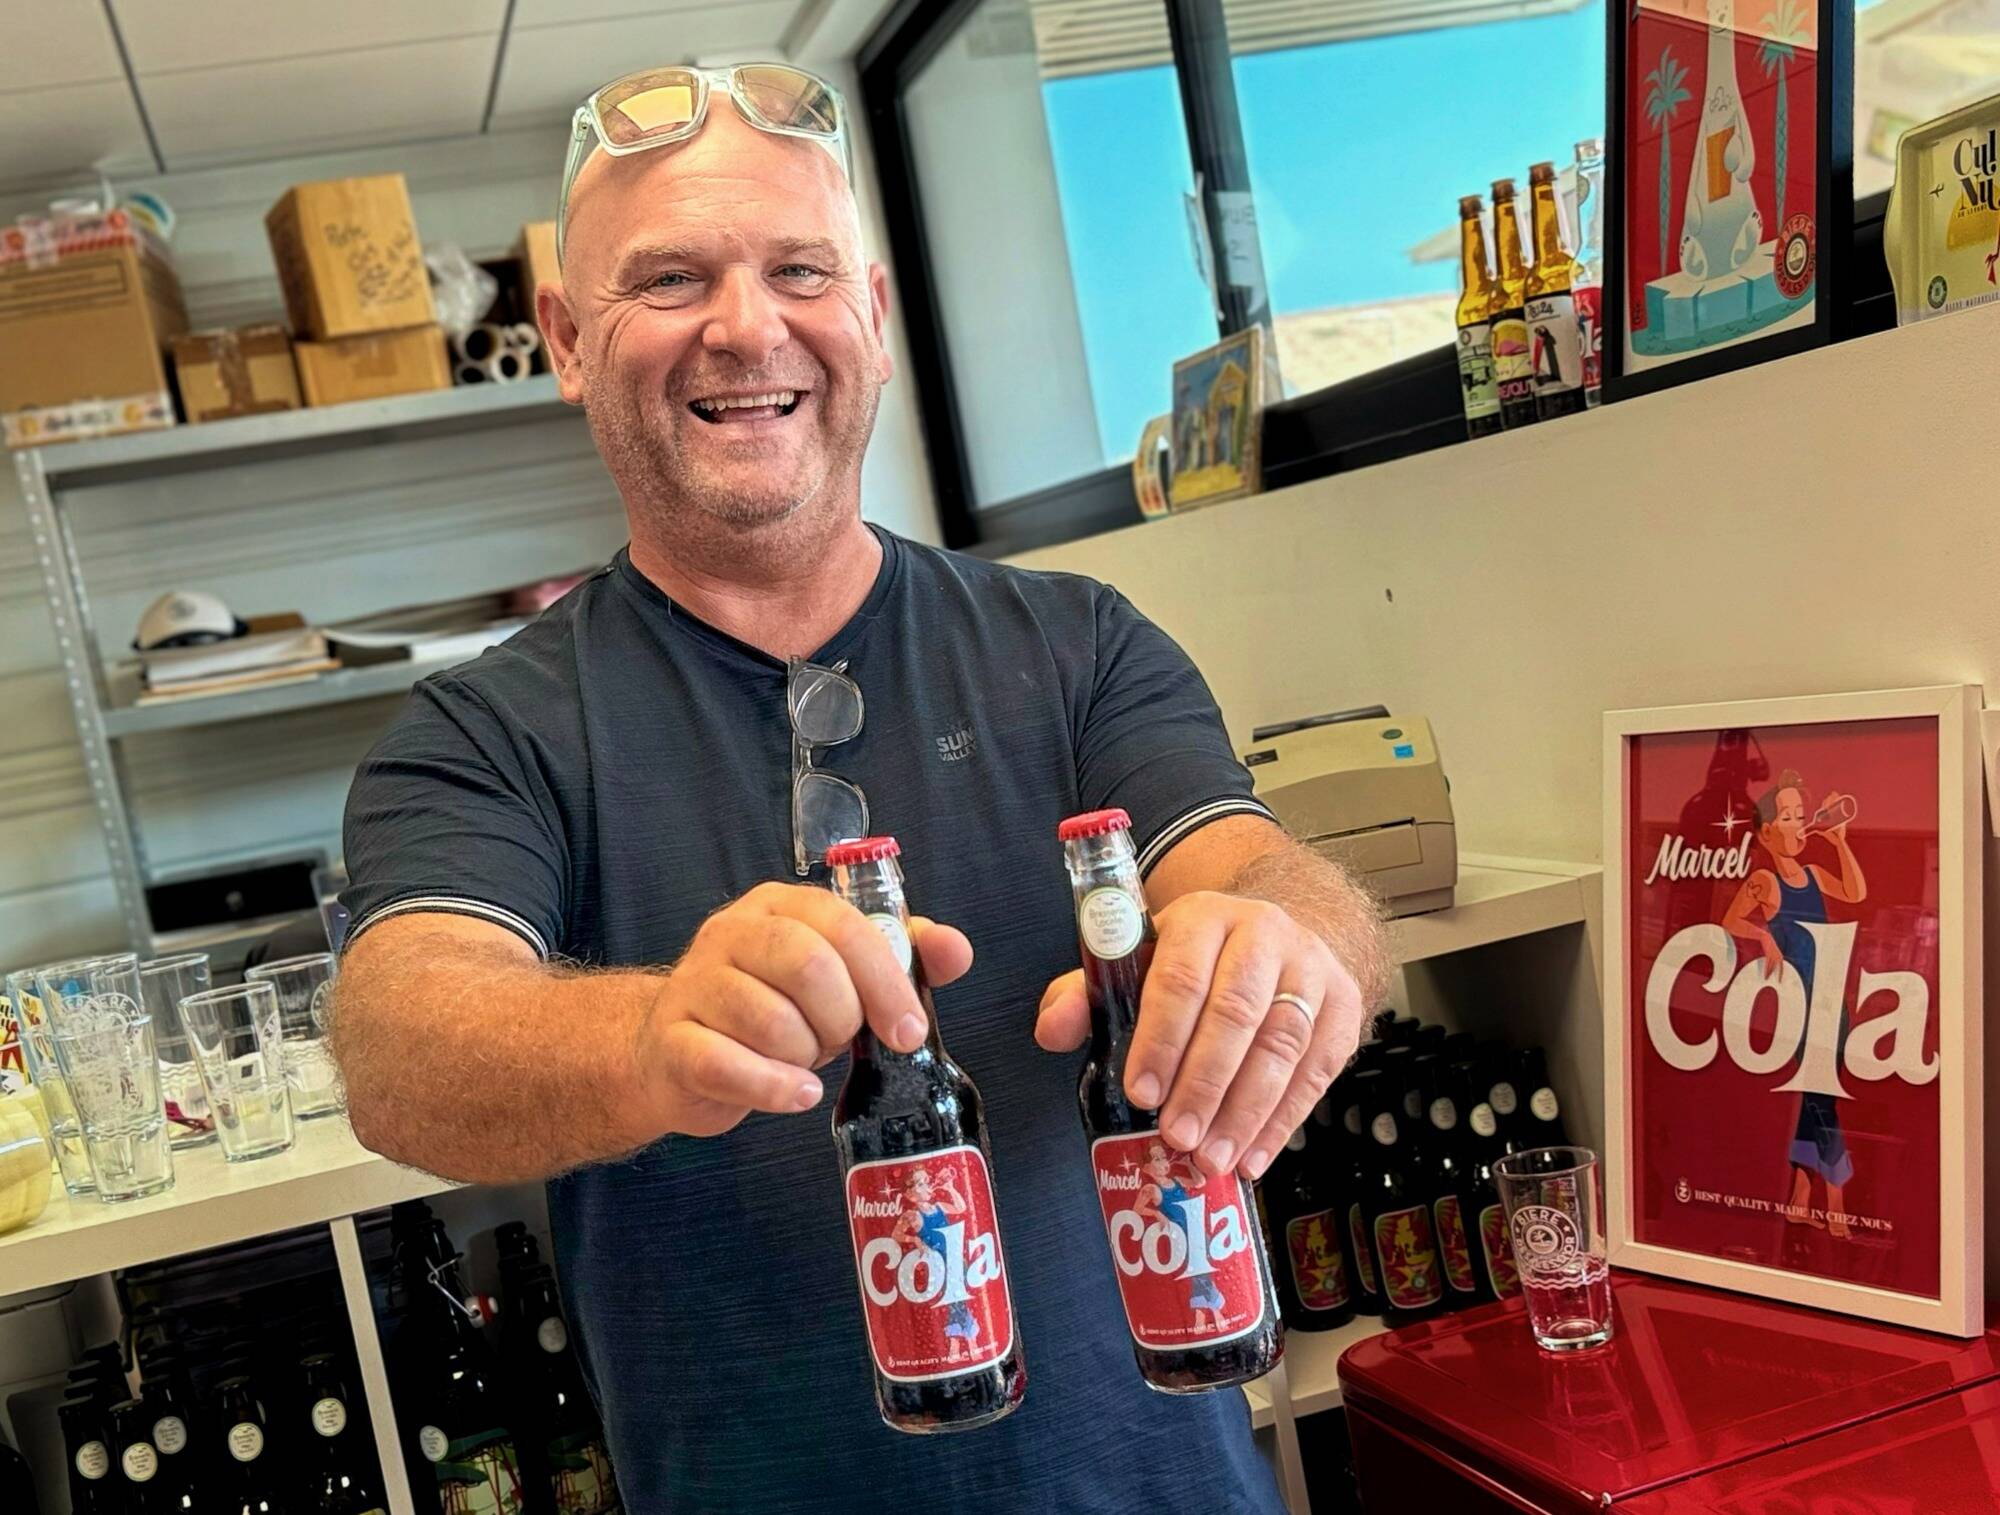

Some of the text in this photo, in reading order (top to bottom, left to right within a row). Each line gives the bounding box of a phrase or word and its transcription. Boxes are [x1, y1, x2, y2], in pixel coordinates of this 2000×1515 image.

[936, 727, 975, 752] SUN
[1644, 831, 1753, 886] Marcel
[1645, 921, 1940, 1100] Cola
[1100, 1167, 1142, 1191] Marcel
[853, 1194, 904, 1219] Marcel
[1515, 1208, 1562, 1226] BIERE
[1694, 1189, 1722, 1204] BEST
[1724, 1194, 1772, 1212] QUALITY
[1774, 1202, 1809, 1218] MADE
[1810, 1208, 1824, 1220] IN
[1826, 1211, 1858, 1227] CHEZ
[1860, 1216, 1893, 1231] NOUS
[1111, 1194, 1248, 1281] Cola
[862, 1220, 1001, 1309] Cola
